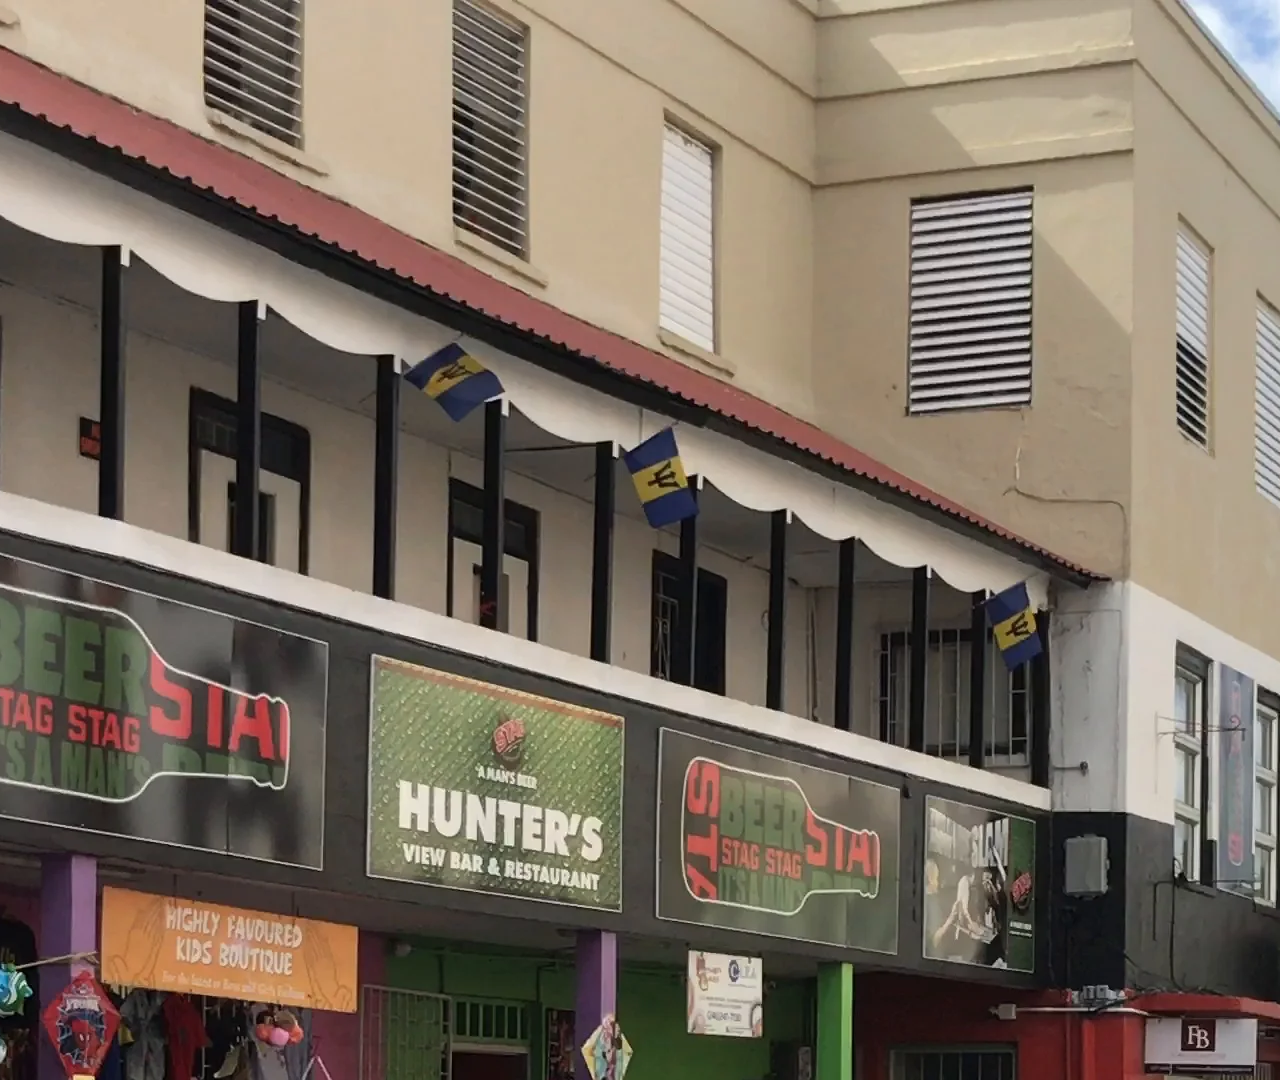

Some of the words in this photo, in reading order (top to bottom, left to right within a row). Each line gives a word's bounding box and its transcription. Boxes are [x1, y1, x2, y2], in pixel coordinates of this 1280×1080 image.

[67, 704, 141, 754] STAG
[31, 734, 54, 788] A
[397, 779, 604, 863] HUNTER'S
[720, 775, 806, 854] BEER
[403, 843, 447, 868] VIEW
[450, 851, 485, 873] BAR
[487, 857, 500, 877] &
[504, 860, 600, 891] RESTAURANT
[722, 837, 761, 872] STAG
[765, 847, 803, 880] STAG
[971, 817, 1010, 869] SLAM
[165, 904, 220, 936] HIGHLY
[227, 915, 303, 948] FAVOURED
[176, 935, 212, 965] KIDS
[219, 943, 293, 976] BOUTIQUE
[1187, 1024, 1210, 1049] FB
